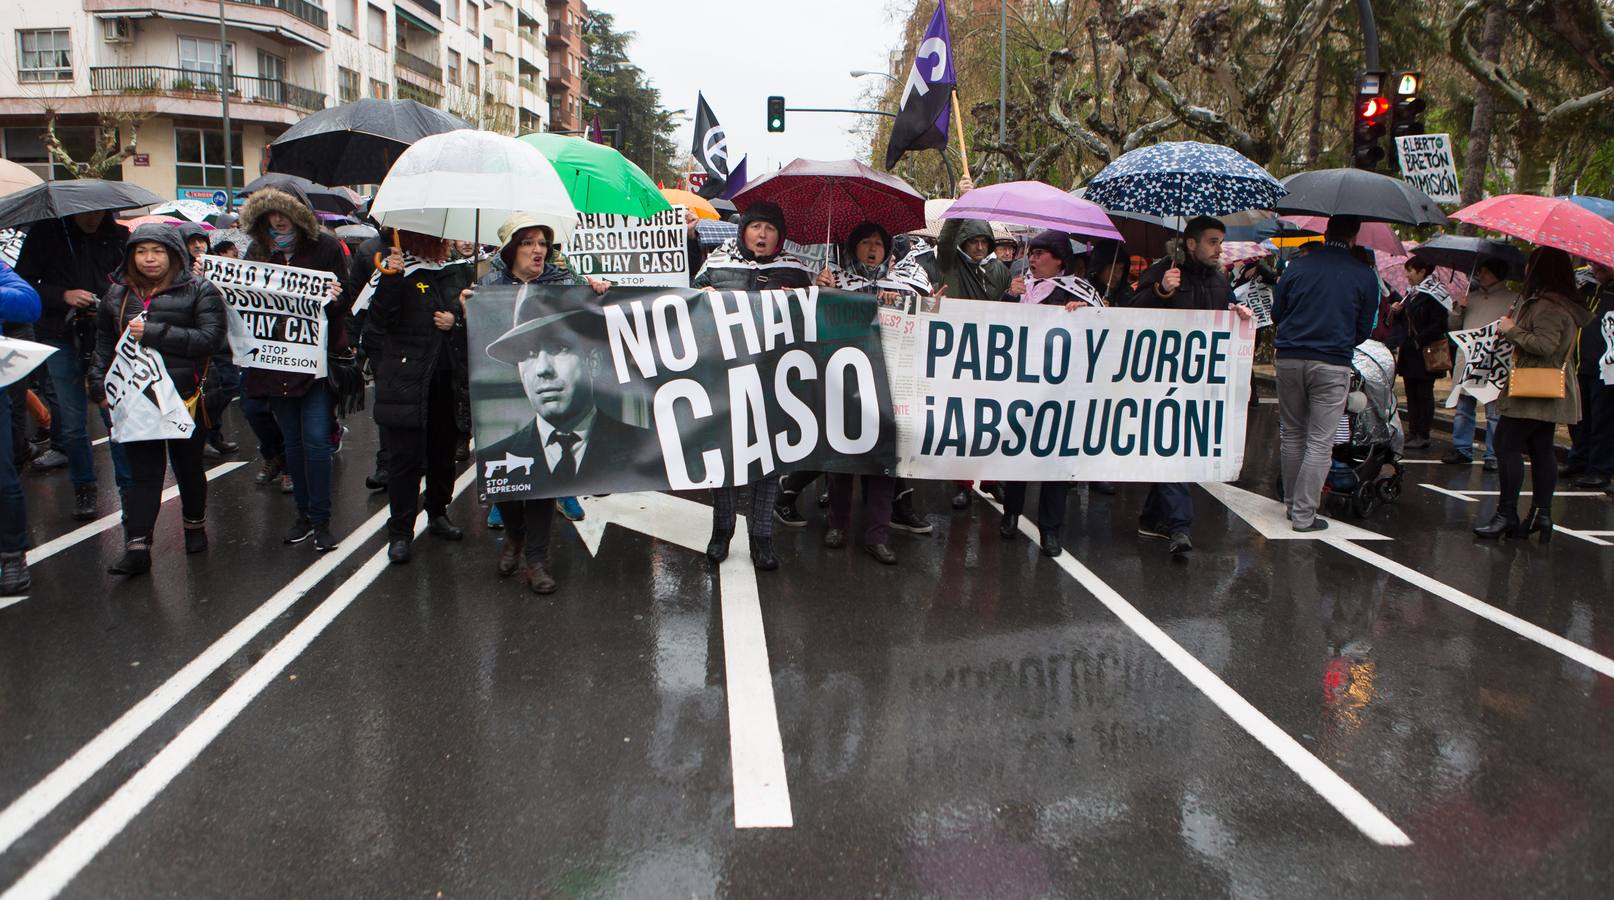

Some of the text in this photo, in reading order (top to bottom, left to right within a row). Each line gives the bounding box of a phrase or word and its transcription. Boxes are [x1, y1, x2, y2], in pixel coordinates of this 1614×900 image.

[1403, 137, 1444, 153] ALBERTO
[1404, 149, 1450, 172] BRETÓN
[575, 212, 616, 230] ABLO
[621, 214, 630, 228] Y
[569, 254, 594, 274] NO
[601, 253, 632, 272] HAY
[640, 251, 684, 273] CASO
[203, 258, 333, 297] PABLO Y JORGE
[620, 277, 645, 285] STOP
[603, 285, 819, 384] NO HAY
[261, 345, 287, 355] STOP
[925, 320, 1072, 385] PABLO
[1086, 328, 1109, 383] Y
[1111, 329, 1231, 385] JORGE
[653, 347, 880, 491] CASO
[920, 386, 1225, 457] ¡ABSOLUCIÓN!
[486, 478, 509, 487] STOP
